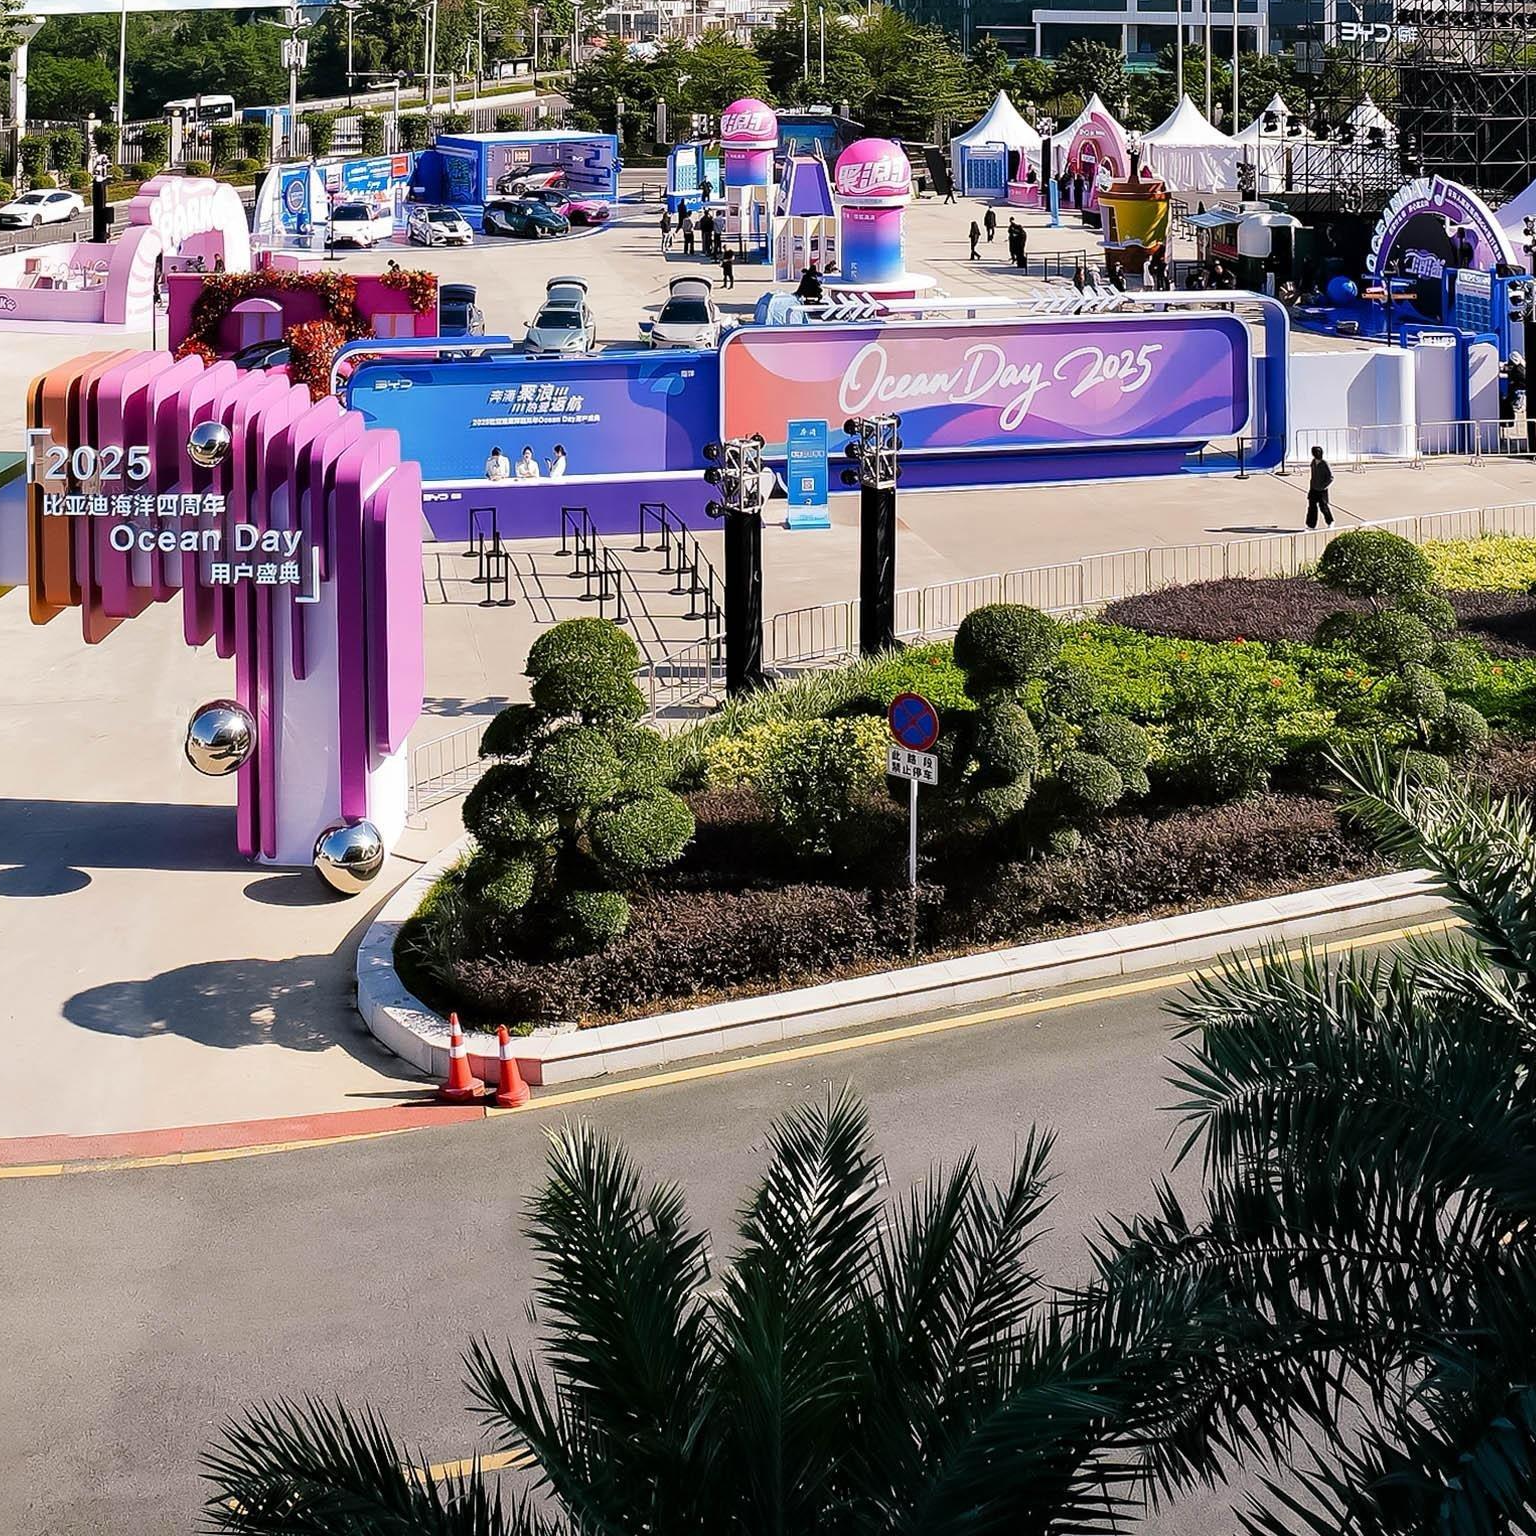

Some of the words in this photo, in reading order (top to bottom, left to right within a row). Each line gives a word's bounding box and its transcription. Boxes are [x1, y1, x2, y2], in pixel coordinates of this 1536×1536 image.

[1341, 21, 1392, 43] BYD
[374, 379, 414, 390] BYD
[838, 341, 964, 415] Ocean
[949, 343, 1054, 432] Day
[1053, 343, 1163, 399] 2025
[43, 445, 153, 483] 2025
[42, 492, 227, 518] 比亚迪海洋四周年
[110, 524, 223, 554] Ocean
[233, 523, 304, 558] Day
[209, 560, 302, 587] 用户盛典
[891, 761, 934, 781] 禁止停车
